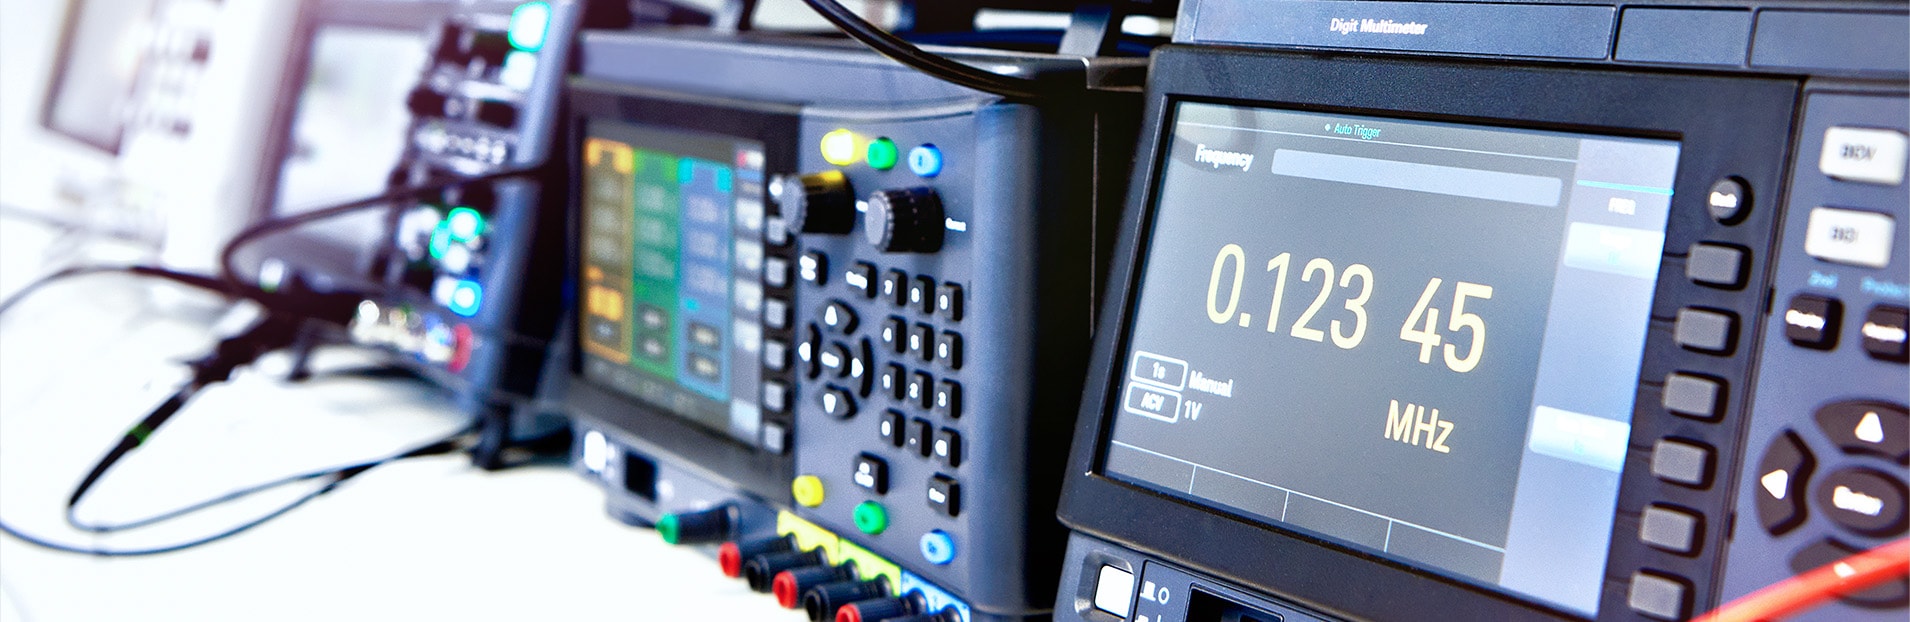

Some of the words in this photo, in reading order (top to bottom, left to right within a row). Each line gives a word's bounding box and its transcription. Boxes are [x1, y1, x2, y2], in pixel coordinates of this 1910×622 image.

[1330, 18, 1359, 35] Digit
[1360, 19, 1428, 35] Multimeter
[1334, 123, 1352, 135] Auto
[1353, 124, 1381, 139] Trigger
[1195, 143, 1254, 172] Frequency
[1206, 243, 1374, 350] 0.123
[1400, 277, 1493, 373] 45
[1188, 370, 1233, 398] Manual
[1140, 392, 1165, 411] ACV
[1184, 399, 1203, 421] 1V
[1384, 399, 1454, 454] MHz
